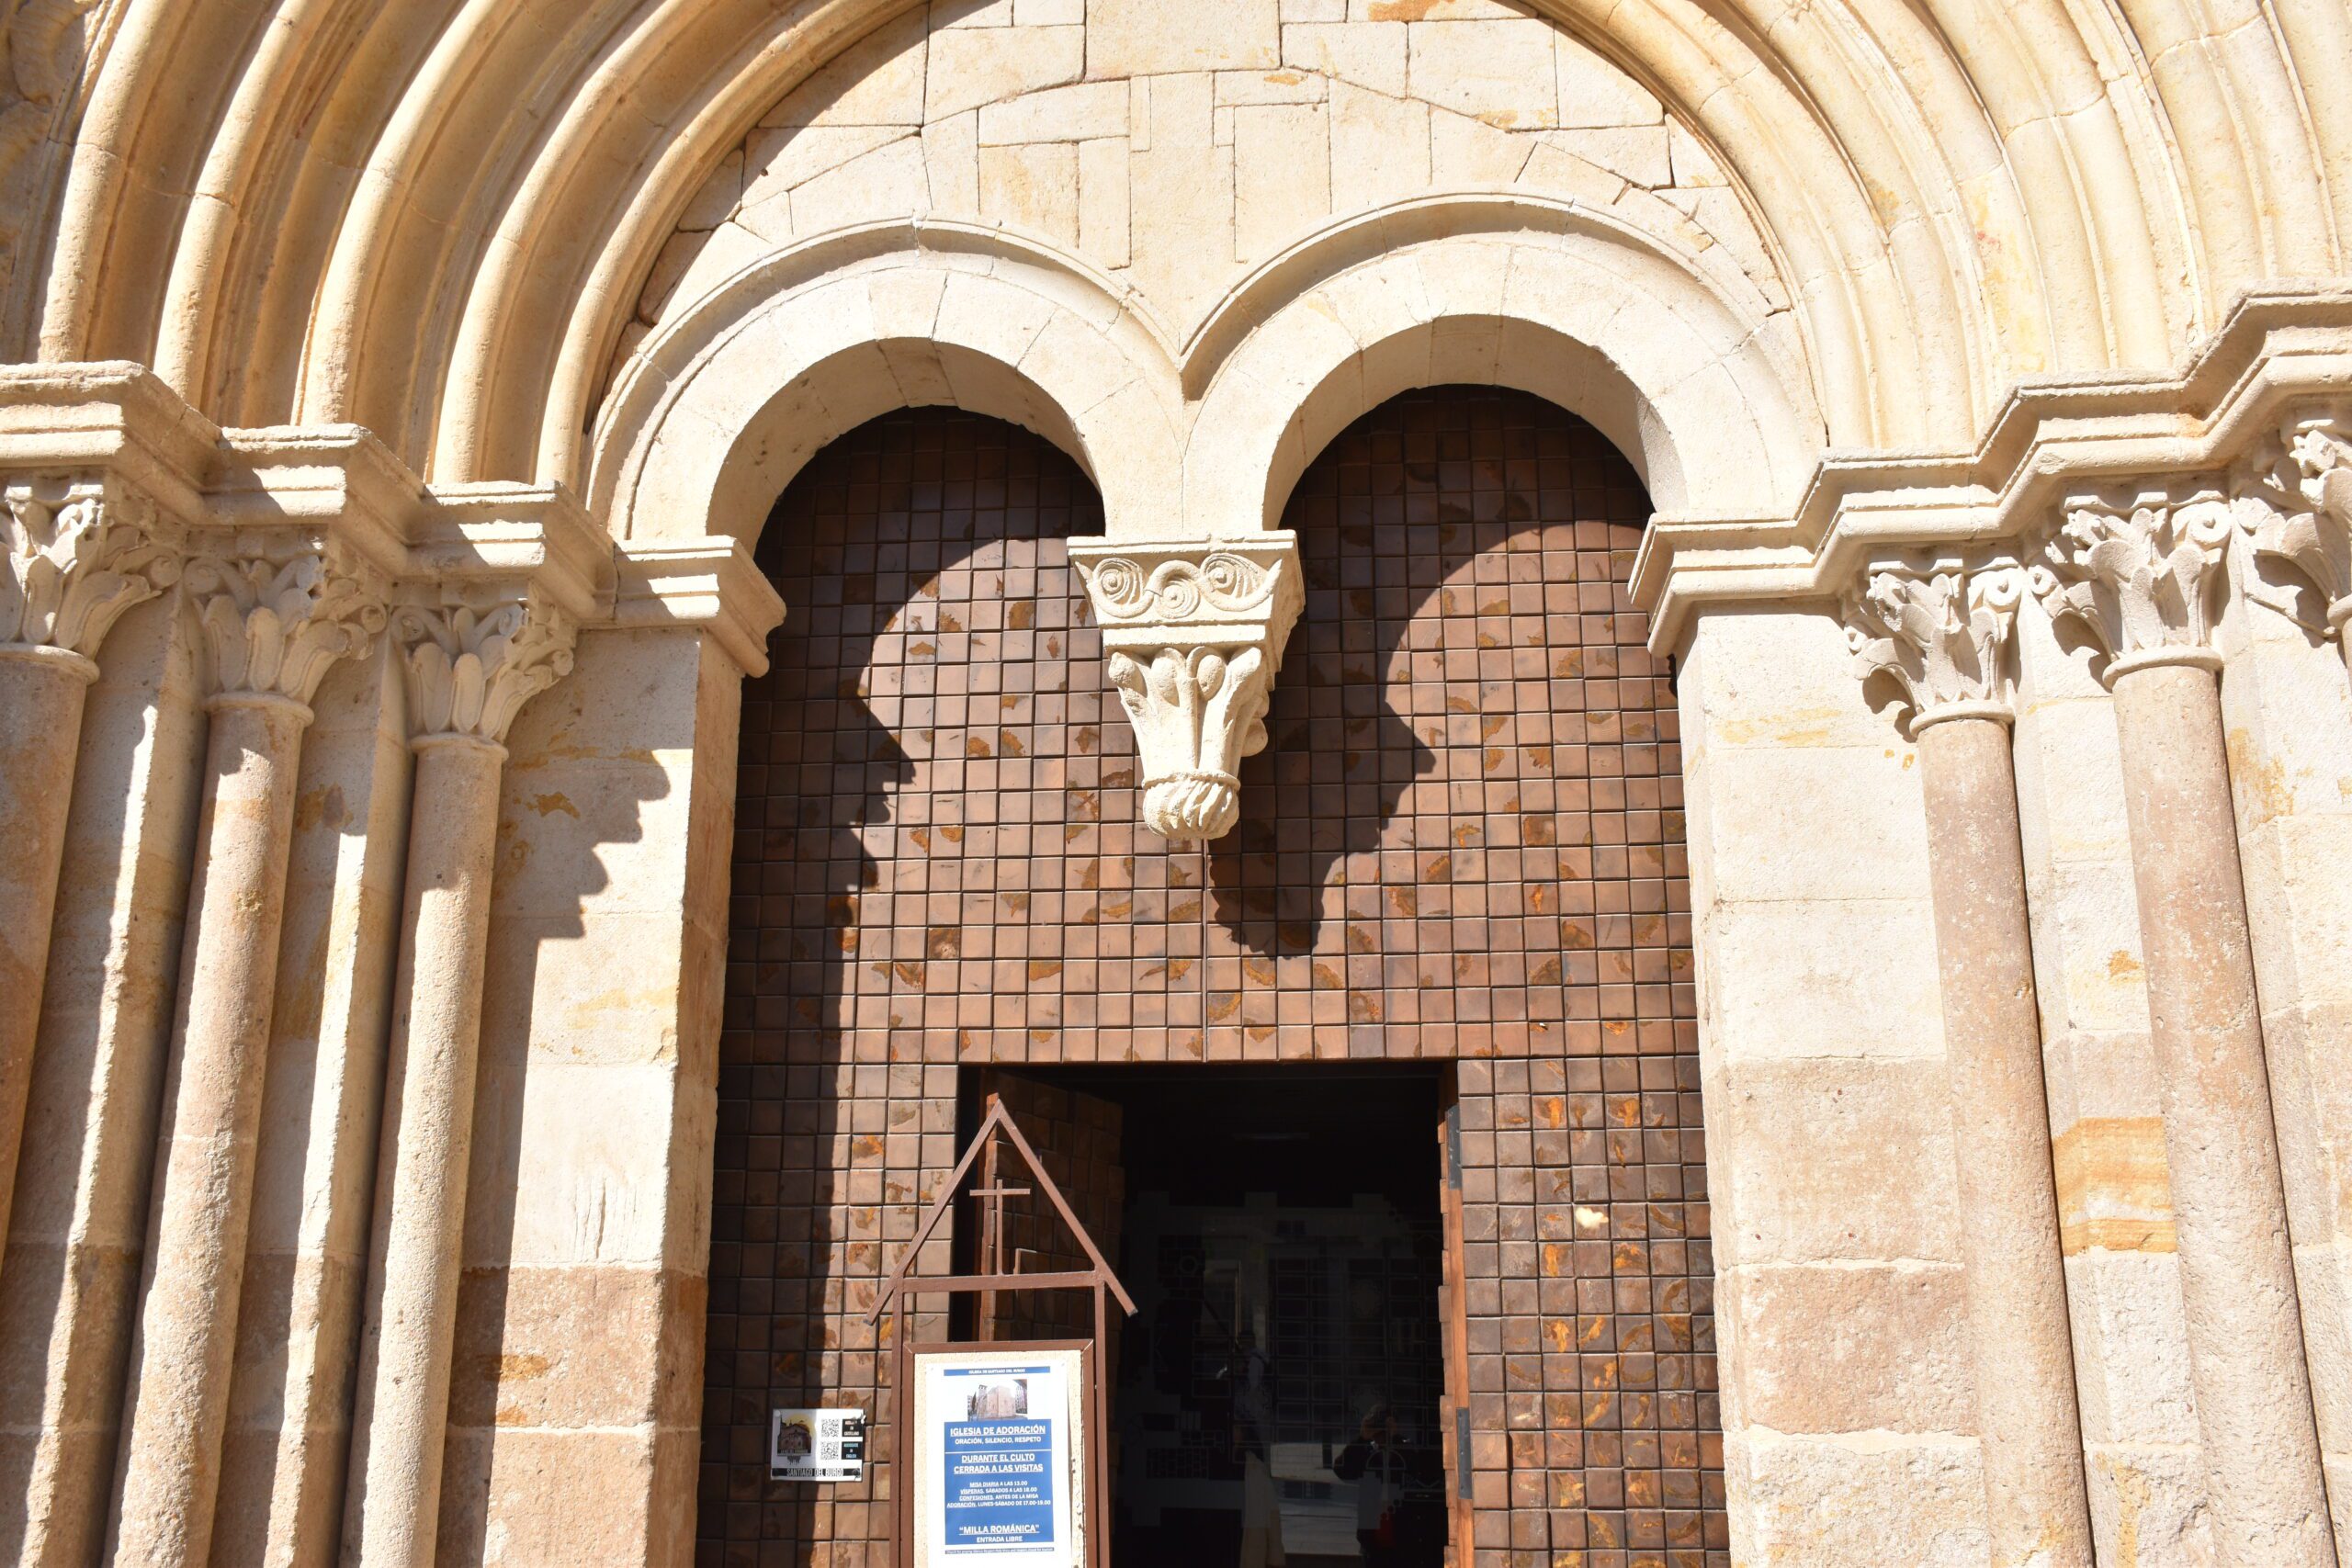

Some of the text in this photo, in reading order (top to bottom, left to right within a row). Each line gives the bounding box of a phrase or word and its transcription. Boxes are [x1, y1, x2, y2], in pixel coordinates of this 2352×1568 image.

[950, 1424, 1046, 1437] IGLESIA DE ADORACIÓN
[961, 1453, 1035, 1463] DURANTE EL CULTO
[786, 1468, 844, 1477] SANTIAGO DEL BURGO
[954, 1465, 990, 1474] CERRADA
[1014, 1464, 1044, 1472] VISITAS
